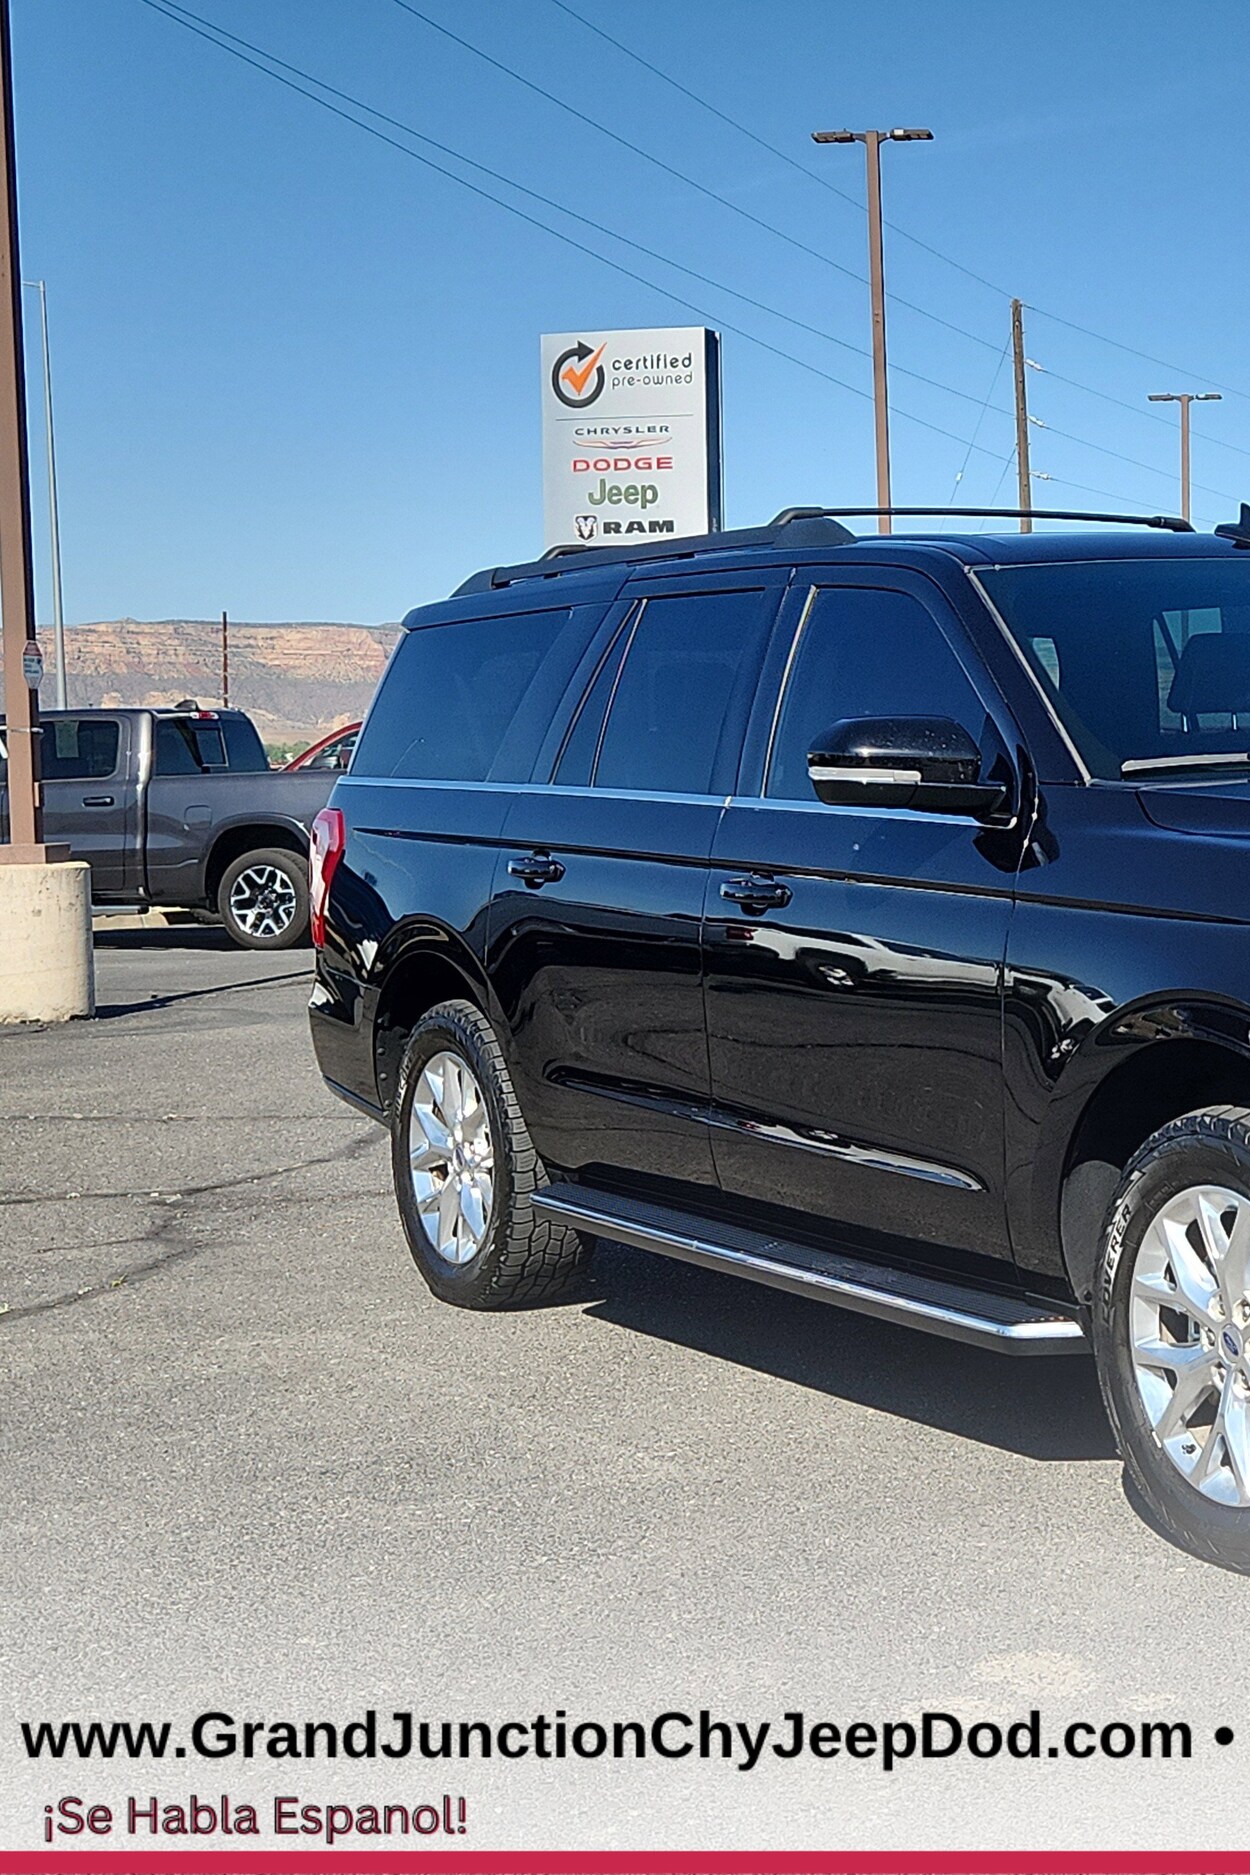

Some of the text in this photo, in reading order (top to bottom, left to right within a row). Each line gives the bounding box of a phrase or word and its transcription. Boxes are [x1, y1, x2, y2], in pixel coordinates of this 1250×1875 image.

[612, 352, 693, 371] certified
[612, 372, 693, 390] pre-owned
[574, 424, 670, 436] CHRYSLER
[573, 457, 673, 472] DODGE
[588, 479, 658, 509] Jeep
[603, 520, 674, 534] RAM
